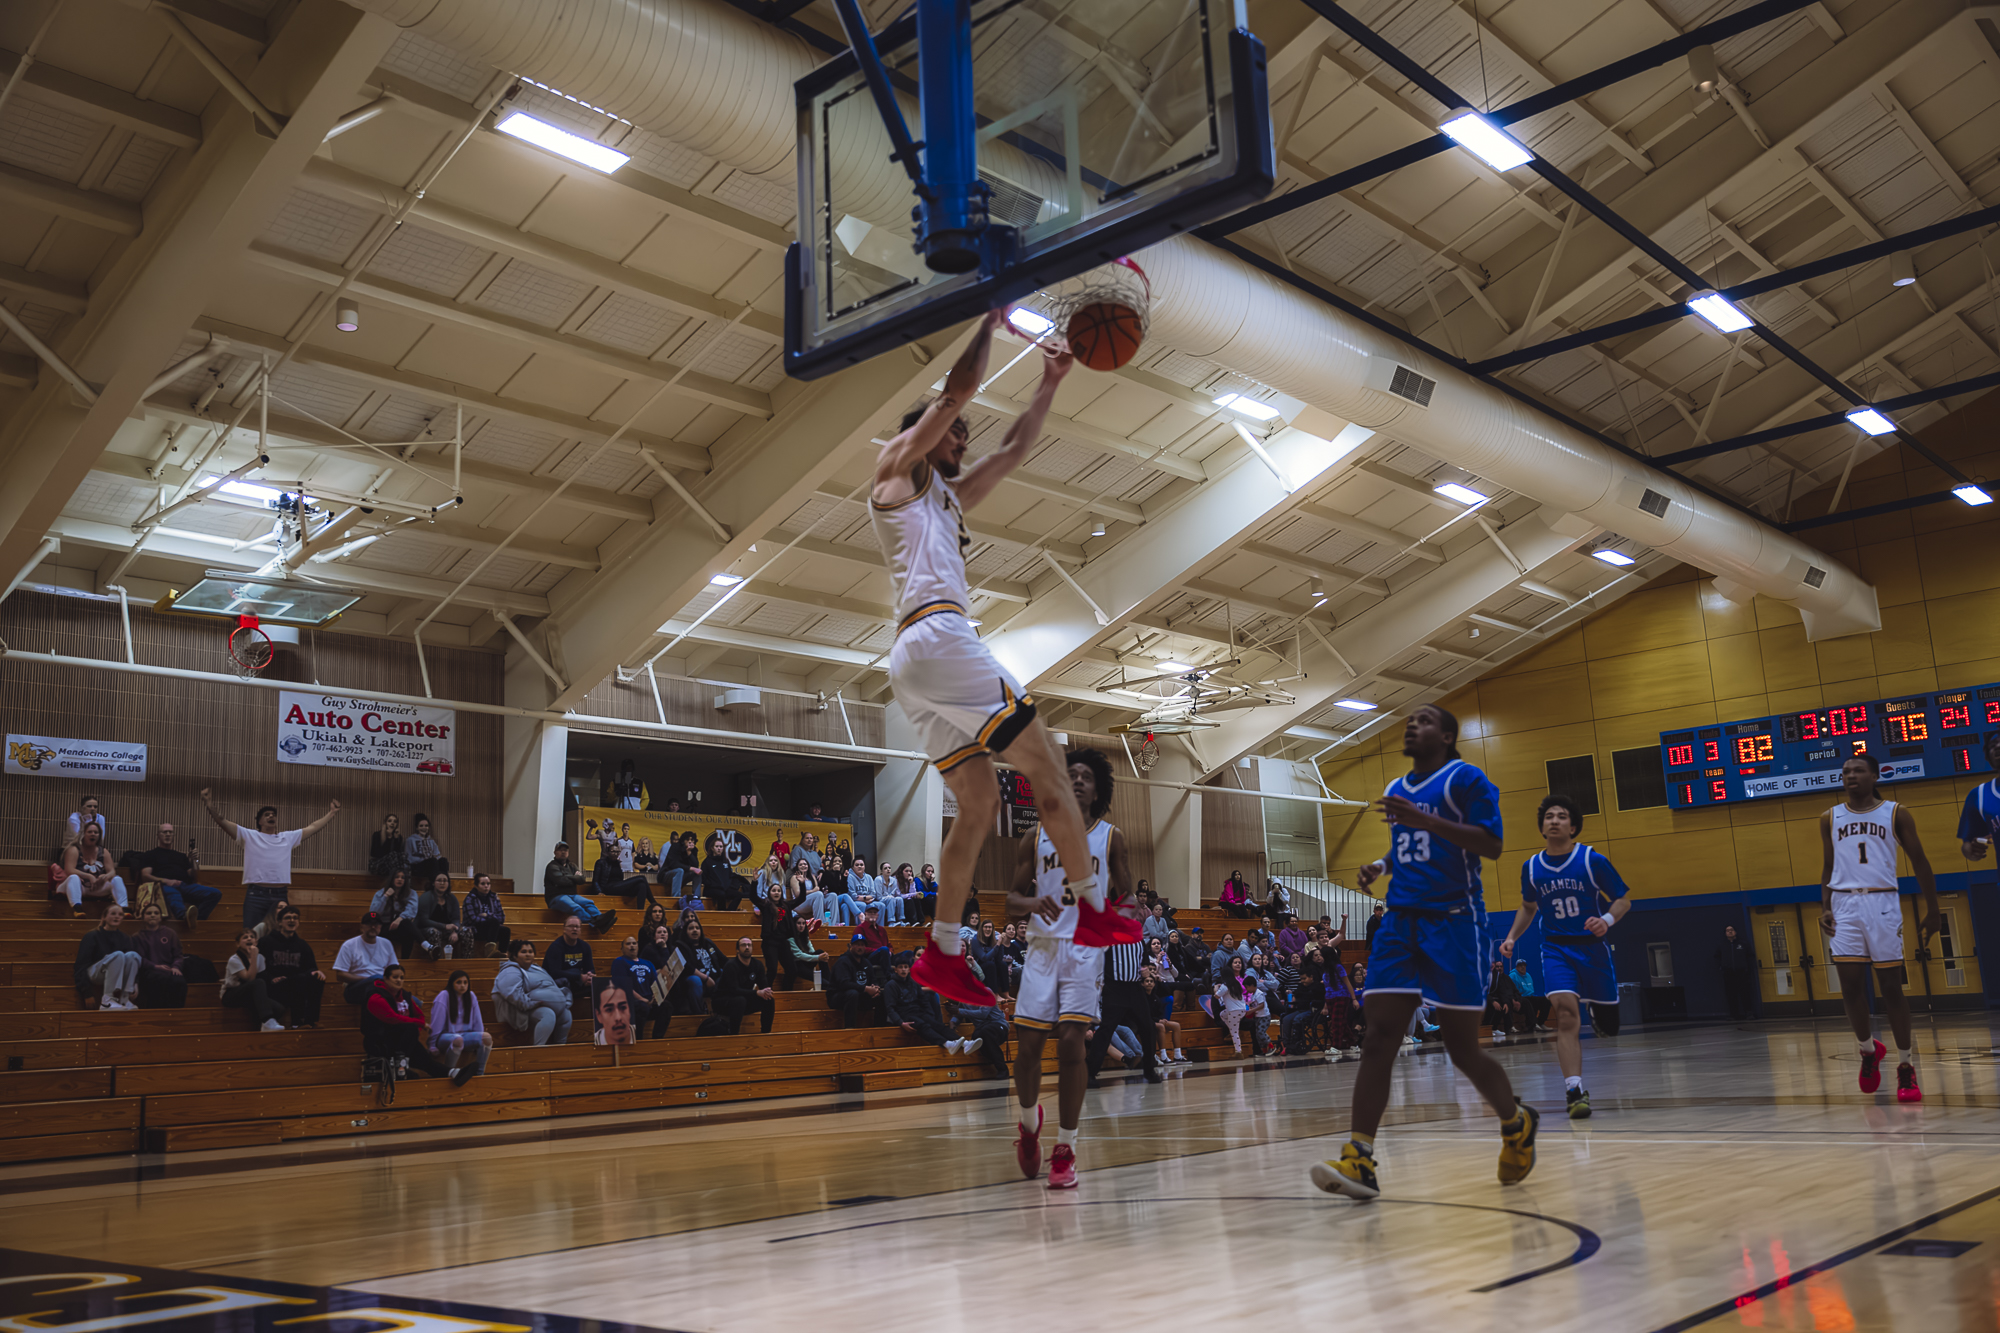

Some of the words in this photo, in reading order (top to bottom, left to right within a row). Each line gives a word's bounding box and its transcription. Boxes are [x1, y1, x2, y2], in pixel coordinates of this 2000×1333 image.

[321, 696, 347, 710] Guy
[349, 699, 418, 716] Strohmeier's
[1885, 700, 1916, 713] Guests
[1938, 692, 1967, 705] player
[284, 703, 353, 730] Auto
[361, 712, 451, 740] Center
[1939, 705, 1971, 730] 24
[1984, 701, 2000, 724] 2
[1737, 723, 1760, 734] Home
[1887, 712, 1929, 742] 75
[302, 729, 348, 744] Ukiah
[352, 734, 365, 746] &
[371, 736, 434, 752] Lakeport
[1737, 734, 1774, 764] 82
[58, 747, 109, 759] Mendocino
[111, 751, 145, 761] College
[312, 742, 363, 755] 707-462-9923
[376, 748, 424, 761] 707-262-1227
[1668, 744, 1693, 765] 00
[1704, 741, 1719, 761] 3
[1809, 748, 1836, 762] period
[1962, 749, 1971, 770] 1
[60, 760, 115, 772] CHEMISTRY
[117, 764, 142, 773] CLUB
[326, 754, 411, 769] www.GuySellsCars.com
[1895, 764, 1921, 775] PEPSI
[1705, 768, 1724, 778] team
[1748, 781, 1779, 793] HOME
[1783, 778, 1798, 789] OF
[1803, 776, 1825, 787] THE
[1830, 773, 1843, 783] EA
[1685, 784, 1693, 804] 1
[1712, 780, 1727, 801] 5
[1838, 822, 1886, 841] MENDO
[1397, 830, 1430, 864] 23
[1858, 842, 1868, 864] 1
[1551, 896, 1580, 920] 30
